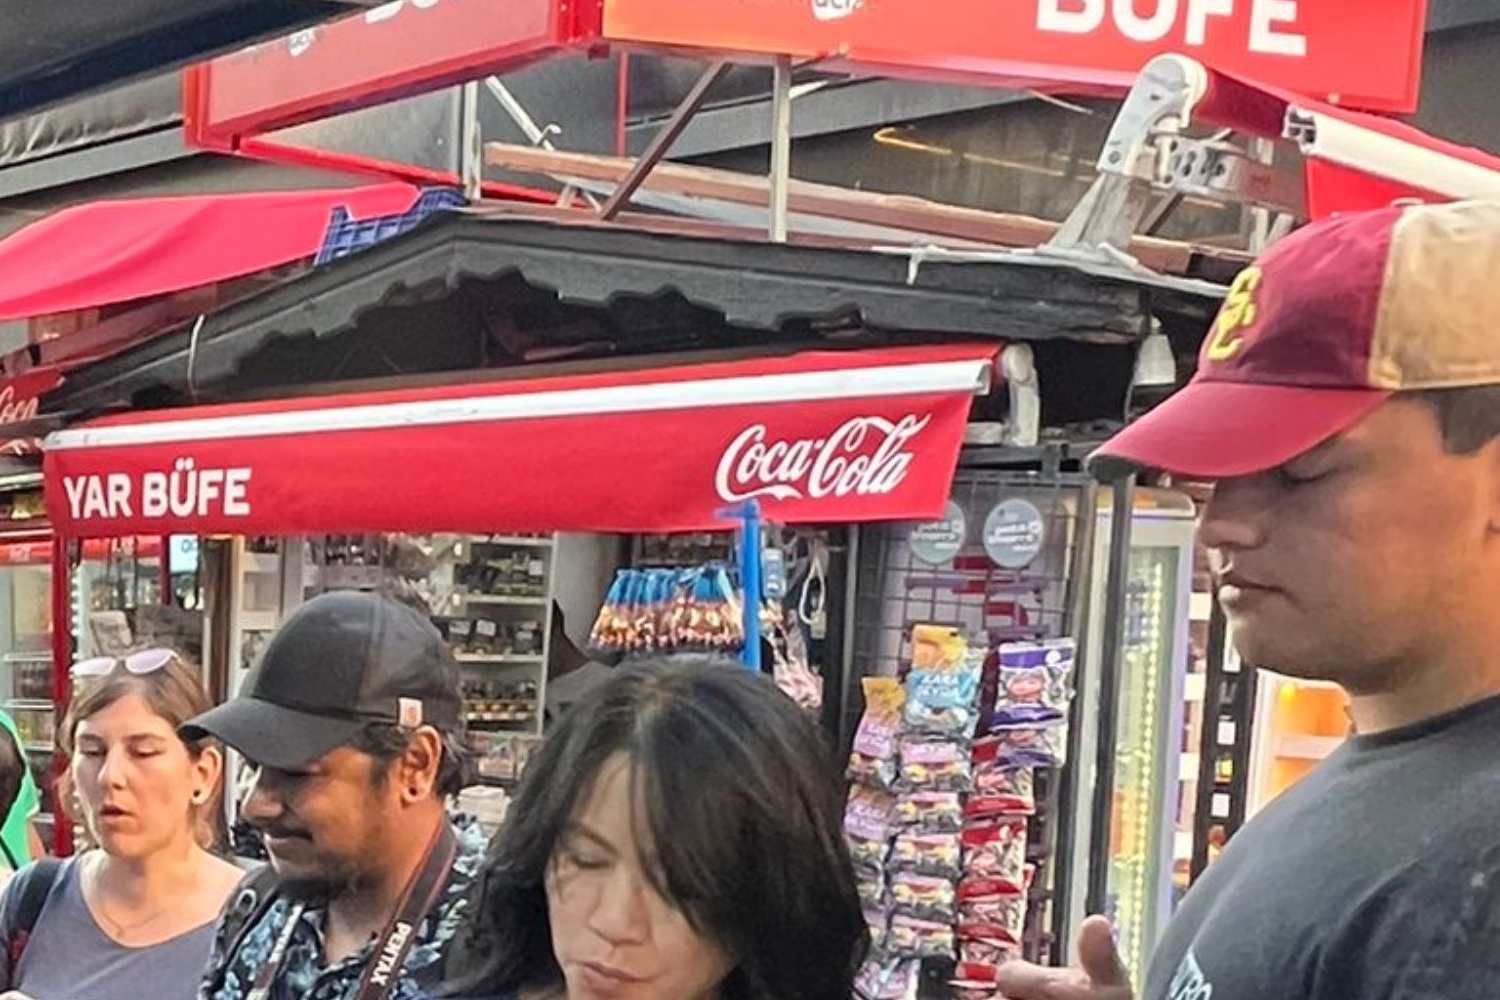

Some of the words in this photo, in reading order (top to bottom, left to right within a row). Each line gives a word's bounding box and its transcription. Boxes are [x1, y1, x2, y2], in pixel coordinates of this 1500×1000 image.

[63, 472, 133, 520] YAR
[142, 457, 252, 518] BÜFE
[715, 413, 932, 503] Coca-Cola
[370, 922, 413, 986] PENTAX
